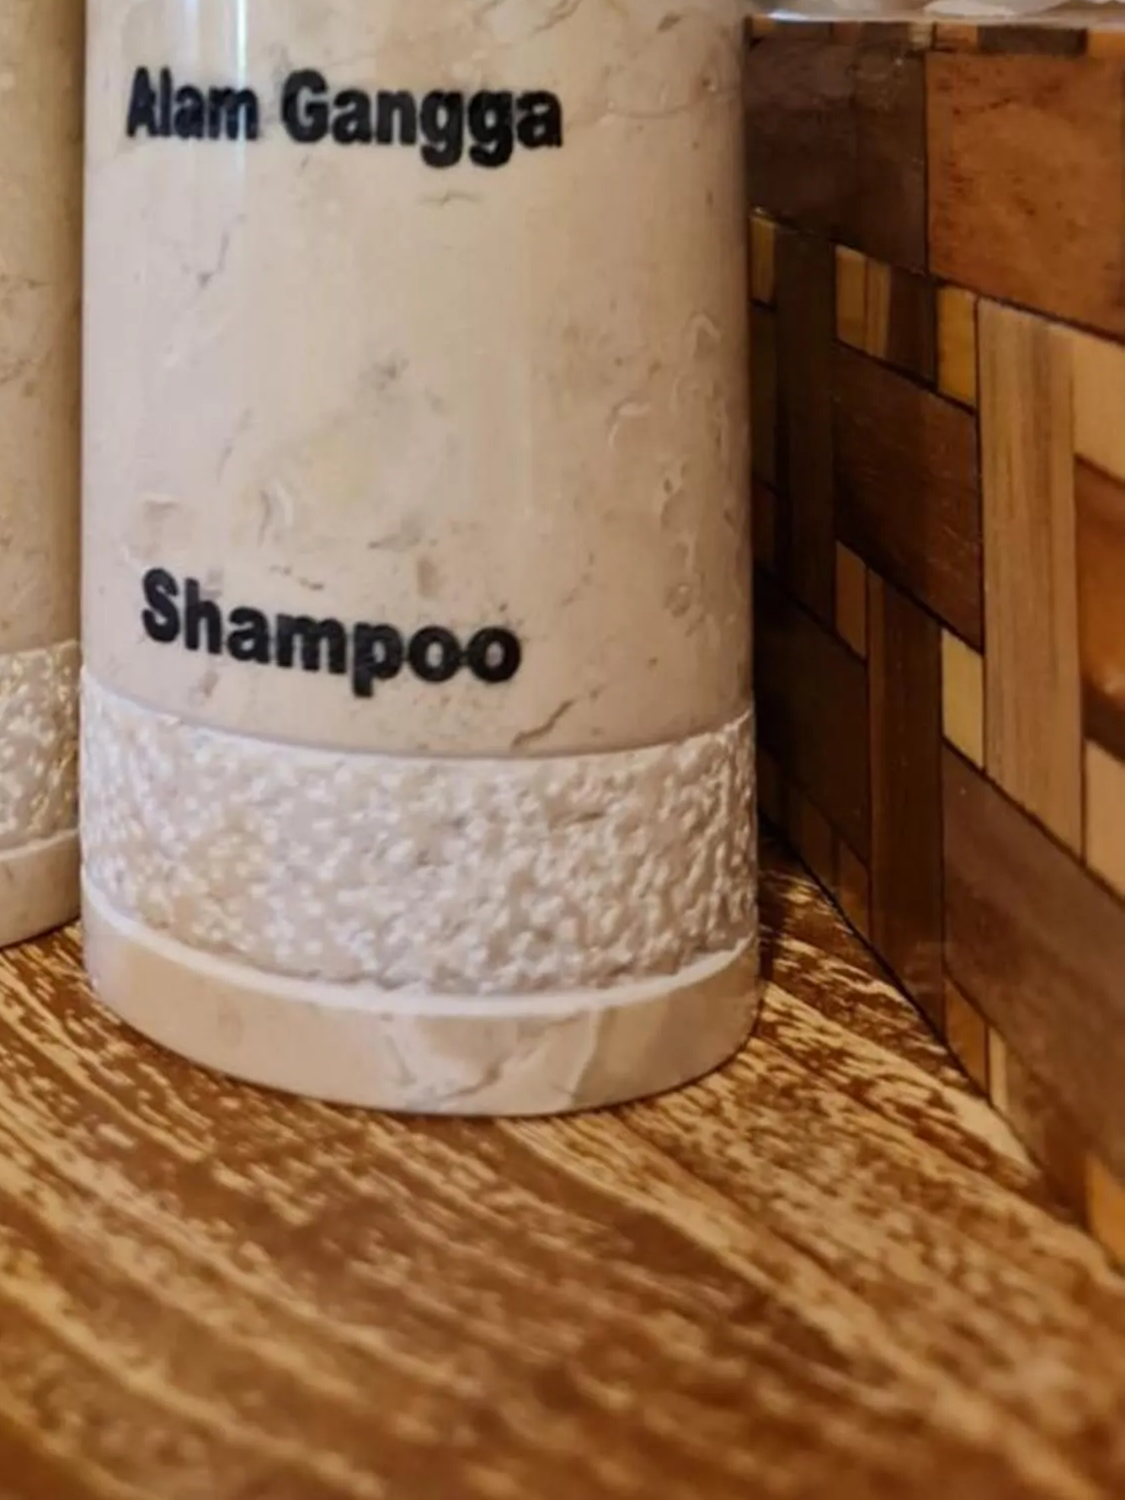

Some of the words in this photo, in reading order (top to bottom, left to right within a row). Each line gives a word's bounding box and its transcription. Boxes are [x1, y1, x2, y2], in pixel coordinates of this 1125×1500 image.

[125, 66, 260, 142] Alam
[279, 68, 564, 170] Gangga
[141, 567, 523, 699] Shampoo
